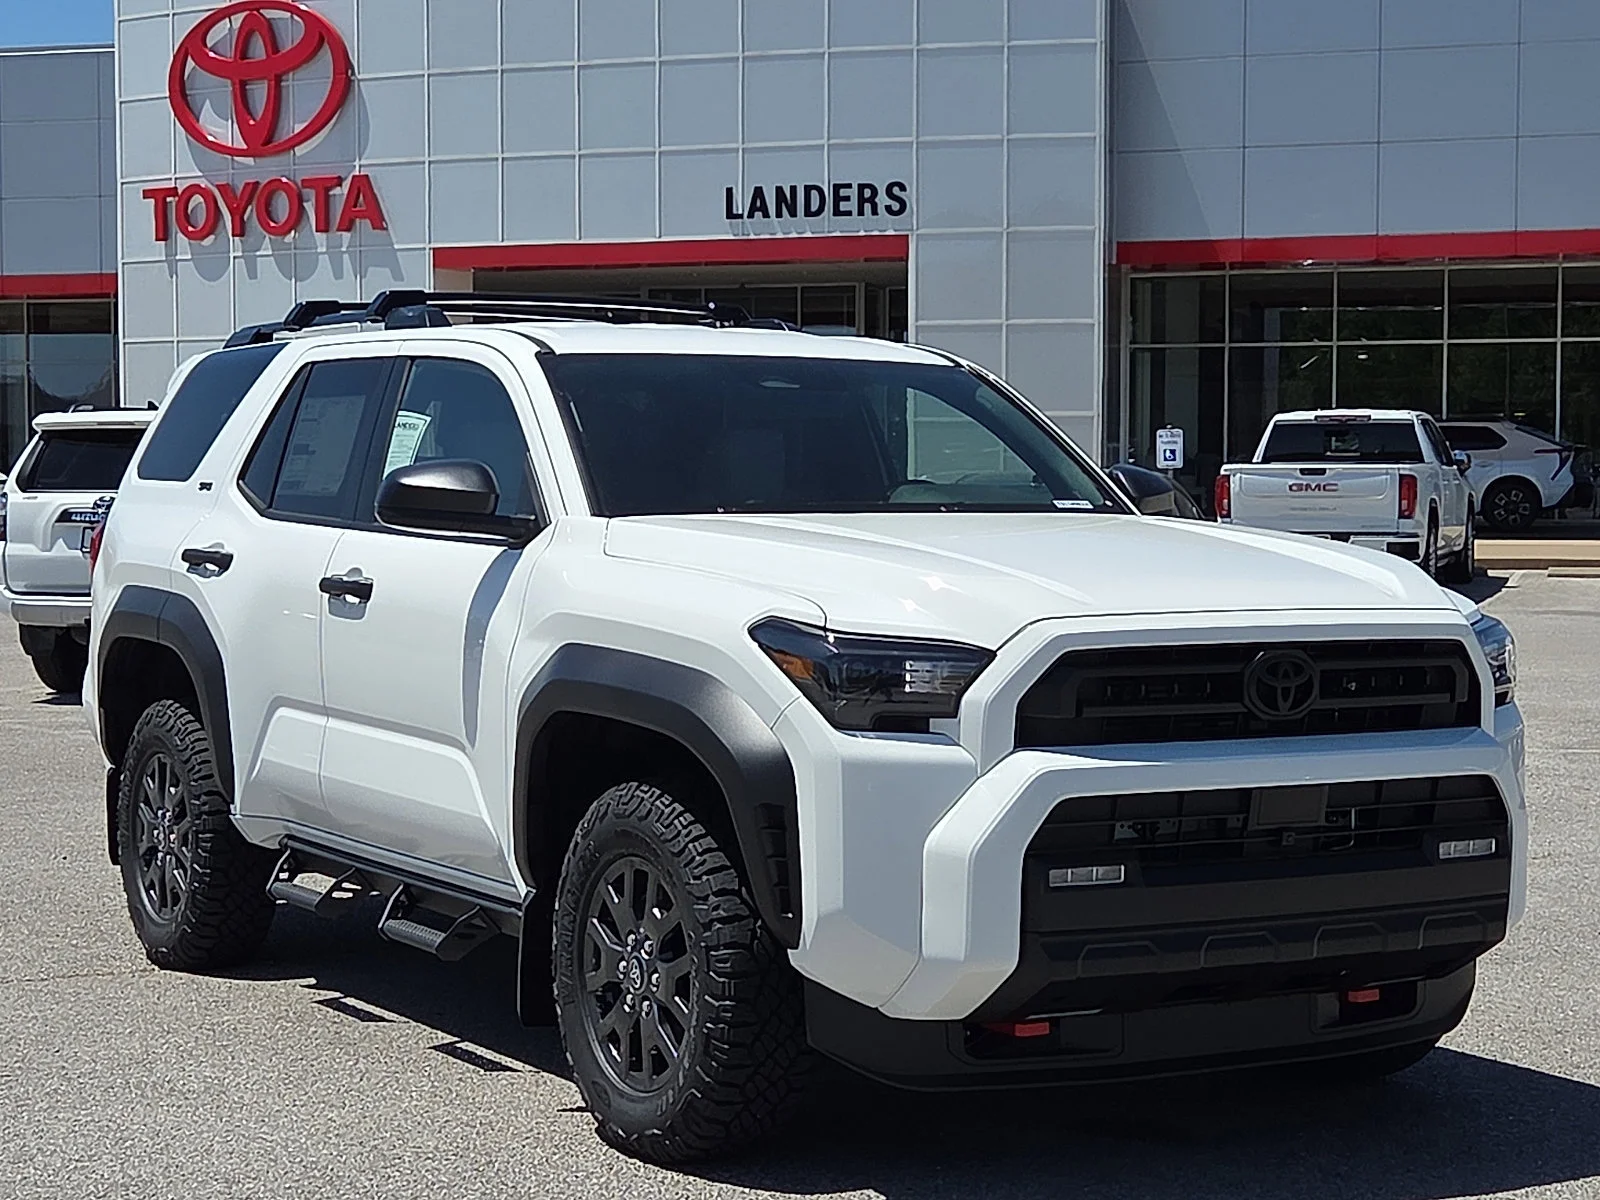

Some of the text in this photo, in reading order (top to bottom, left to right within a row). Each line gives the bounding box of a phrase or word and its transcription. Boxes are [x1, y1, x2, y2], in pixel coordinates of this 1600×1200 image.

[142, 174, 387, 242] TOYOTA
[725, 181, 908, 220] LANDERS
[1288, 482, 1339, 492] GMC
